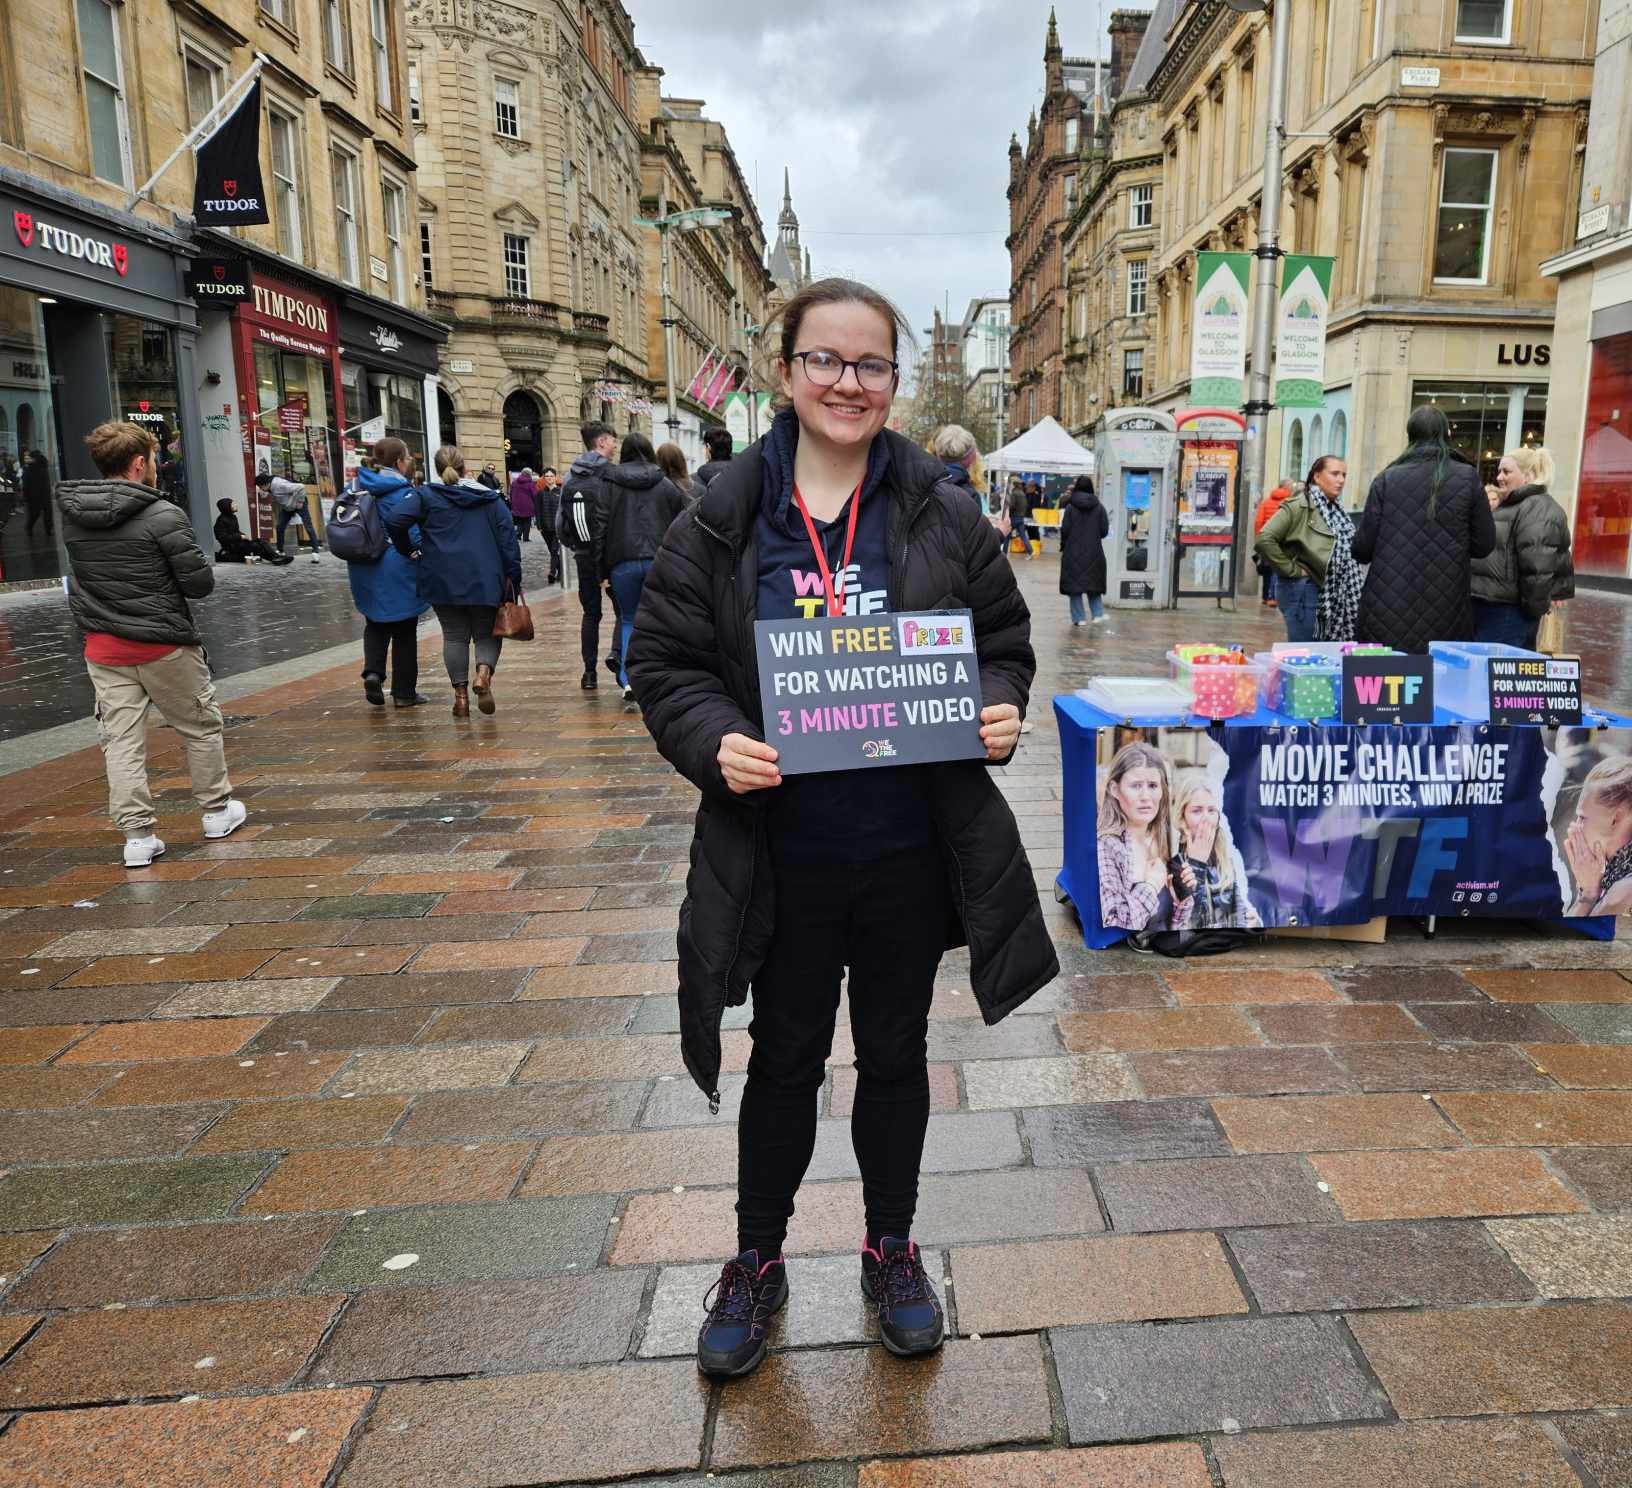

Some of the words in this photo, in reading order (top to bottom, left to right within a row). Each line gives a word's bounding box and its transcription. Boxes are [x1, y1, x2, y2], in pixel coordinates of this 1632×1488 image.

[203, 198, 260, 212] TUDOR
[36, 222, 114, 268] TUDOR
[196, 283, 245, 295] TUDOR
[252, 284, 328, 333] TIMPSON
[260, 328, 270, 339] The
[270, 332, 290, 346] Quality
[1200, 332, 1238, 340] WELCOME
[1214, 340, 1225, 348] TO
[1198, 348, 1239, 356] GLASGOW
[1281, 350, 1318, 358] GLASGOW
[1296, 342, 1306, 350] TO
[1498, 344, 1550, 366] LUS
[128, 413, 164, 422] TUDOR
[790, 564, 862, 596] WE
[768, 630, 824, 658] WIN
[831, 626, 894, 654] FREE
[902, 620, 964, 648] PRIZE
[1492, 662, 1516, 675] WIN
[1518, 662, 1545, 676] FREE
[774, 670, 820, 696] FOR
[825, 662, 948, 692] WATCHING
[954, 660, 969, 684] A
[1494, 680, 1514, 692] FOR
[1515, 680, 1568, 692] WATCHING
[1570, 681, 1576, 692] A
[1354, 676, 1423, 705] WTF
[1494, 696, 1502, 709] 3
[1504, 697, 1544, 709] MINUTE
[1546, 698, 1578, 710] VIDEO
[778, 710, 793, 736] 3
[800, 702, 898, 734] MINUTE
[904, 696, 976, 725] VIDEO
[1260, 744, 1349, 782] MOVIE
[1358, 744, 1509, 782] CHALLENGE
[1260, 784, 1318, 806] WATCH
[1323, 784, 1334, 806] 3
[1338, 784, 1417, 808] MINUTES,
[1420, 784, 1452, 806] WIN
[1454, 784, 1464, 805] A
[1466, 782, 1504, 804] PRIZE
[1260, 816, 1468, 906] WTF
[1456, 880, 1500, 890] activism.wtf
